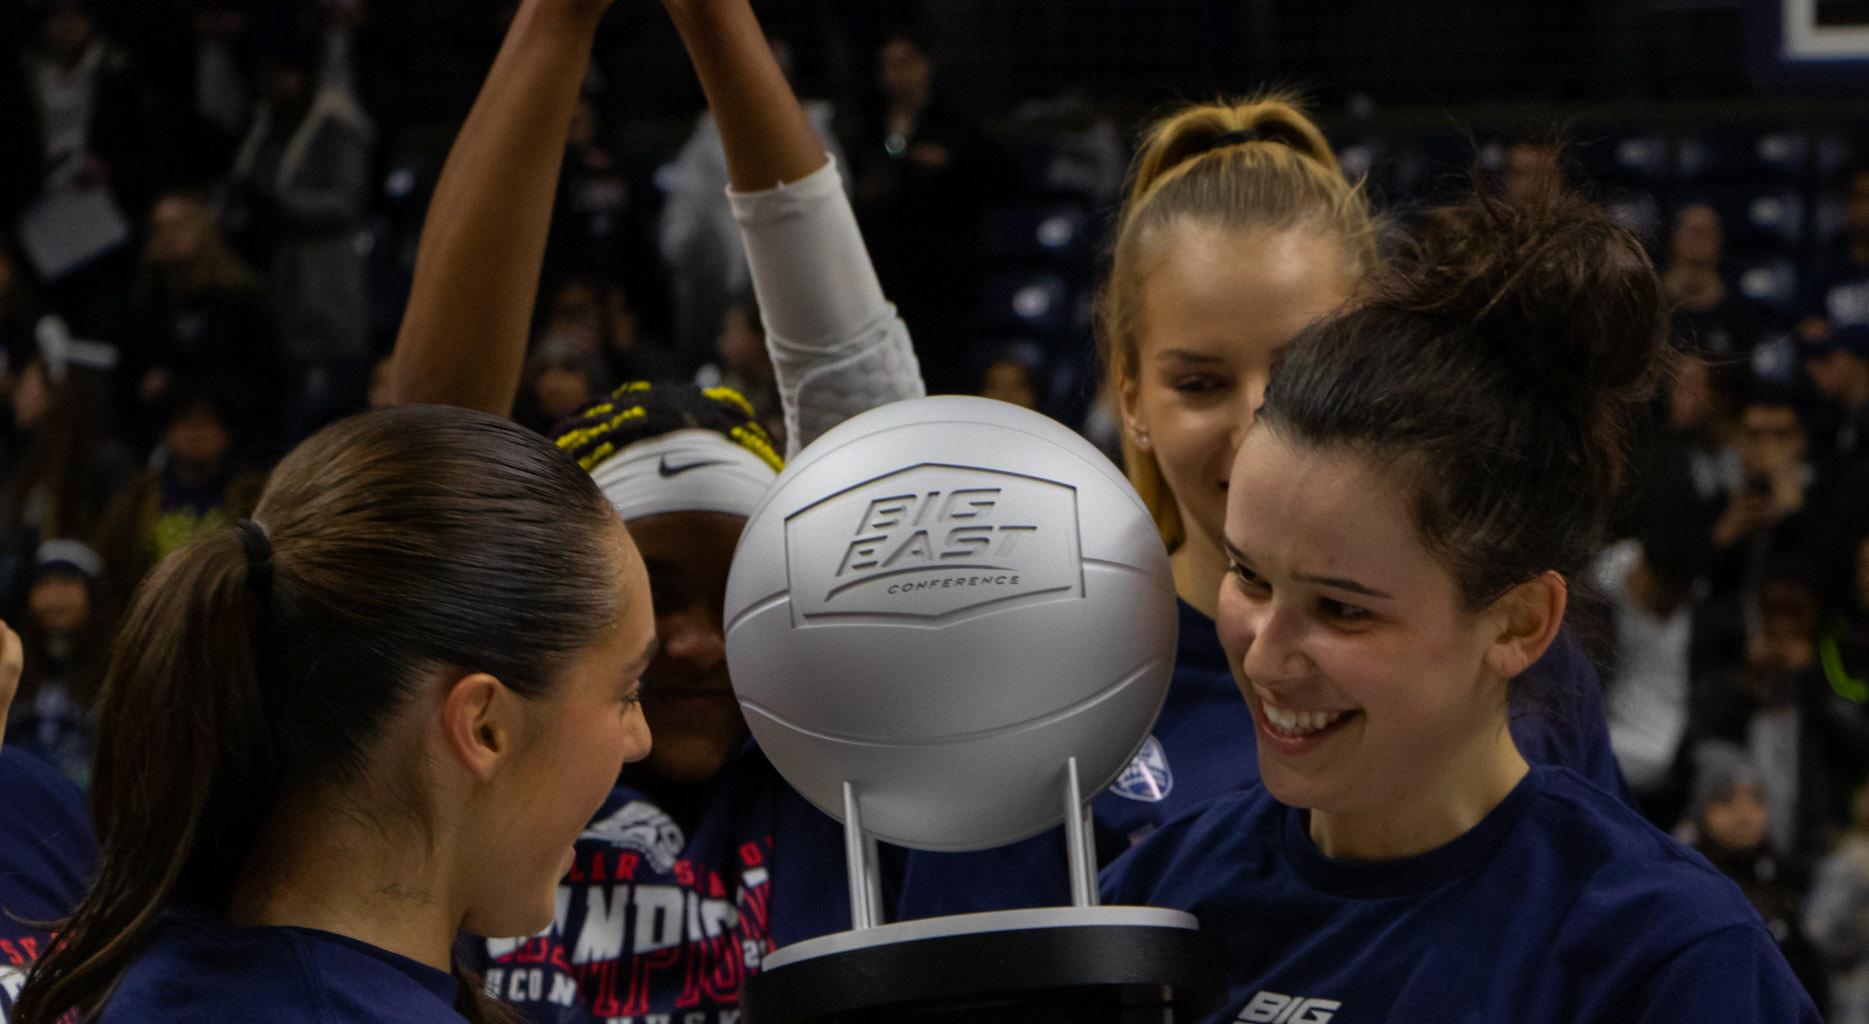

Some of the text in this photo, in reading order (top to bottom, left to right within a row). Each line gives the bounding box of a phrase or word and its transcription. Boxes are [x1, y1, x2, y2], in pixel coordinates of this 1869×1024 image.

[855, 487, 1002, 536] BIG
[835, 525, 1038, 577] EAST
[887, 574, 1020, 595] CONFERENCE
